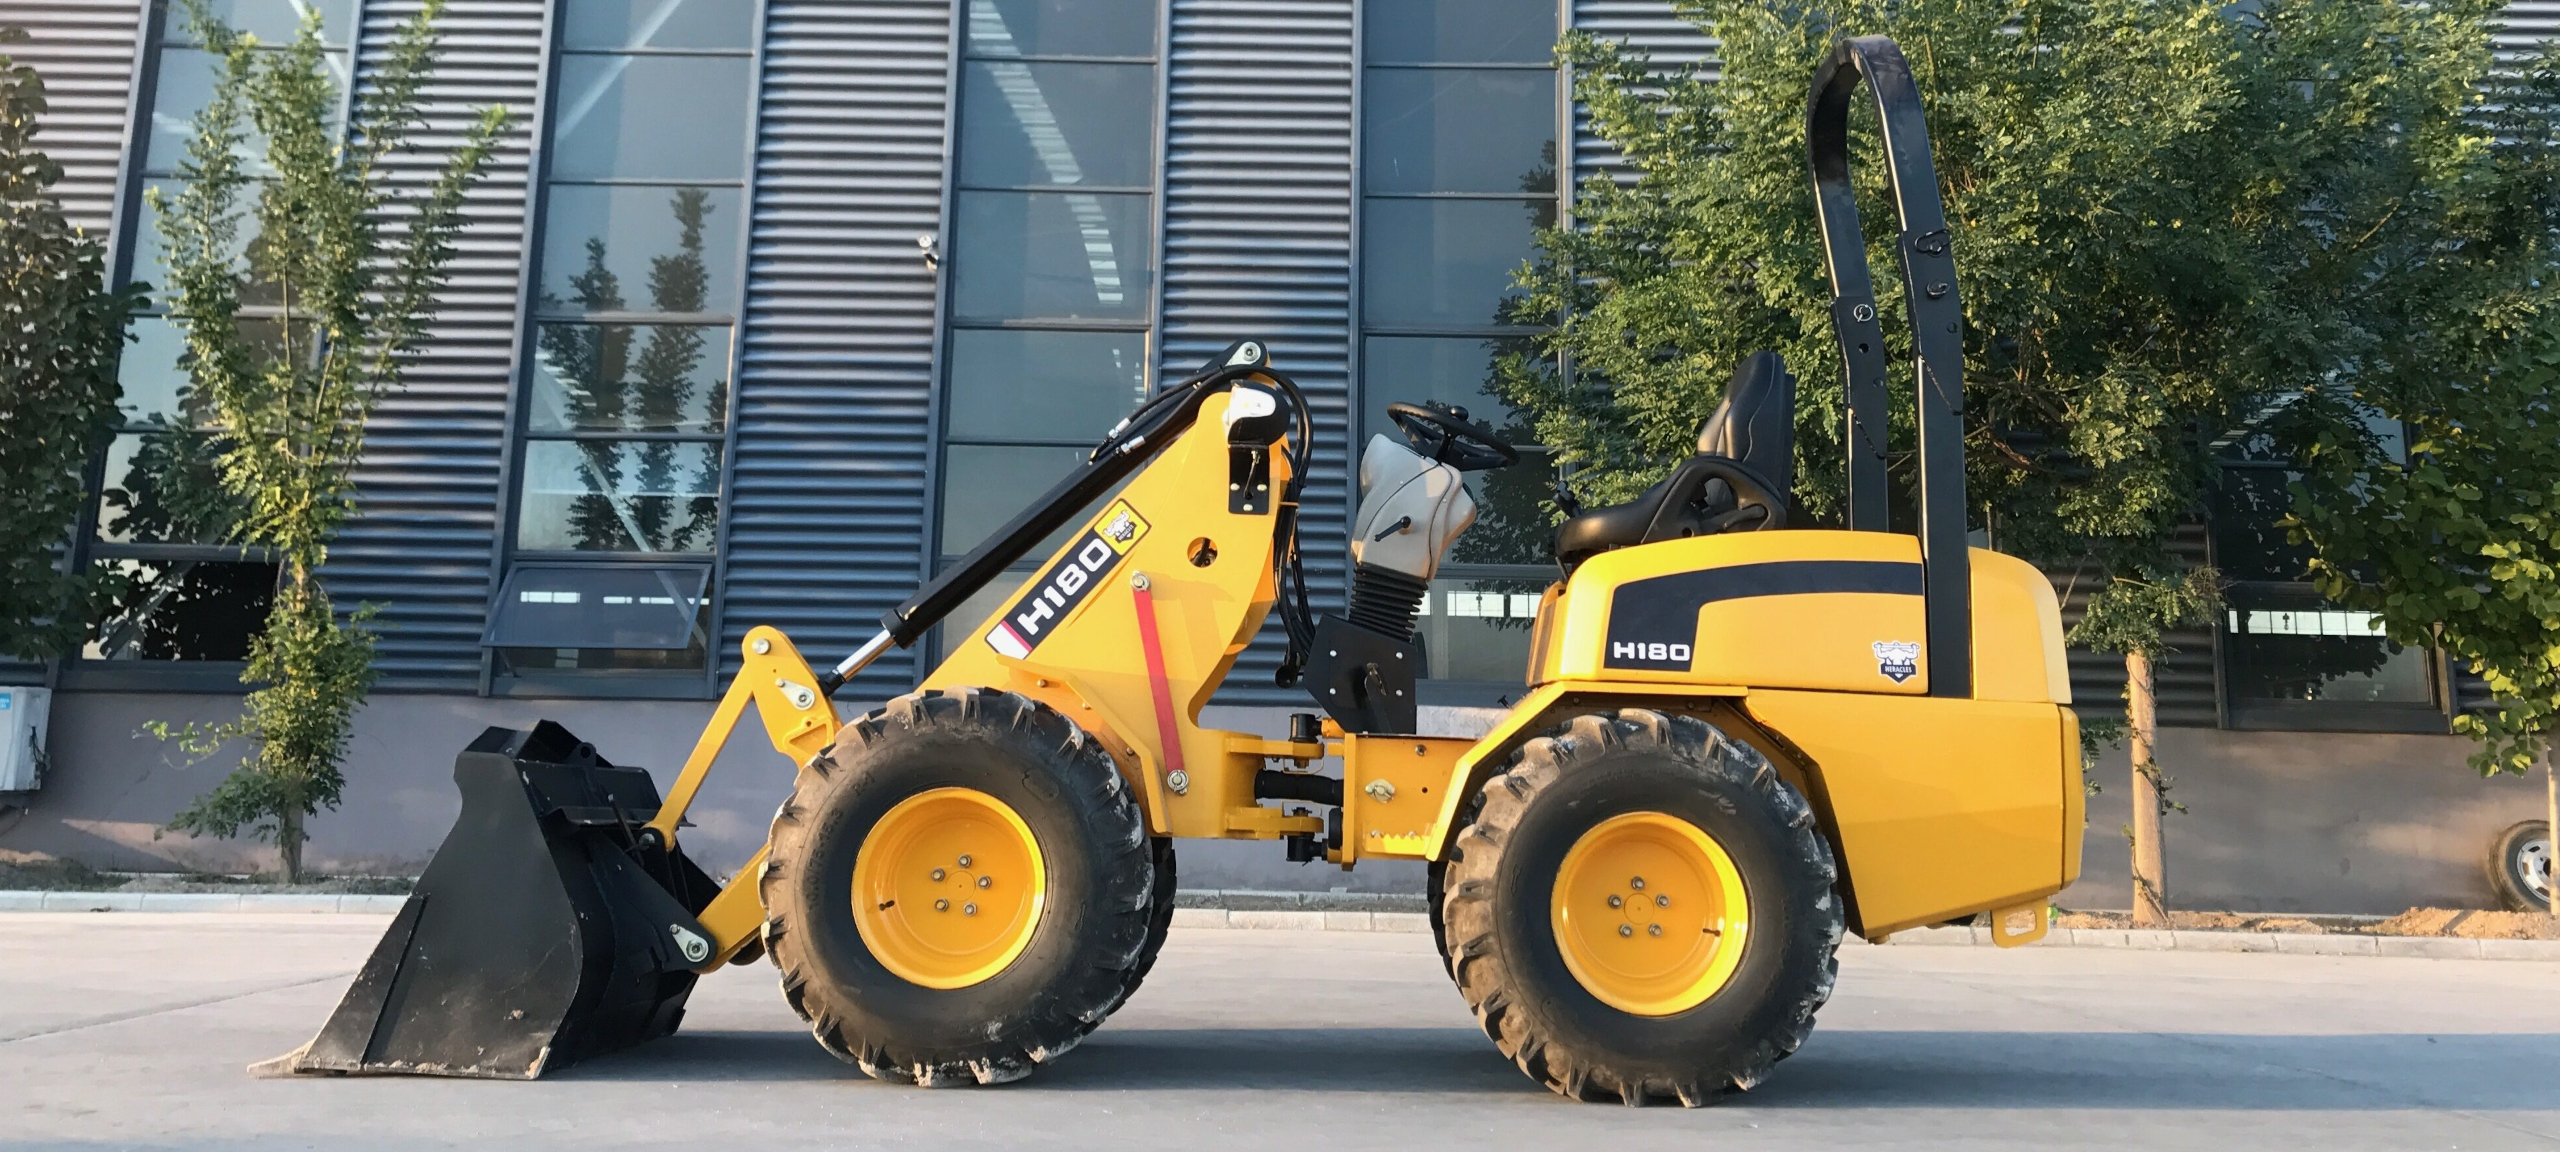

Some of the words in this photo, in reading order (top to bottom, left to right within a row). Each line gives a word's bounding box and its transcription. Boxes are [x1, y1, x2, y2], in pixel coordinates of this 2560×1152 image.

[1017, 538, 1112, 636] H180
[1613, 641, 1691, 662] H180
[1884, 665, 1913, 674] HERACLES
